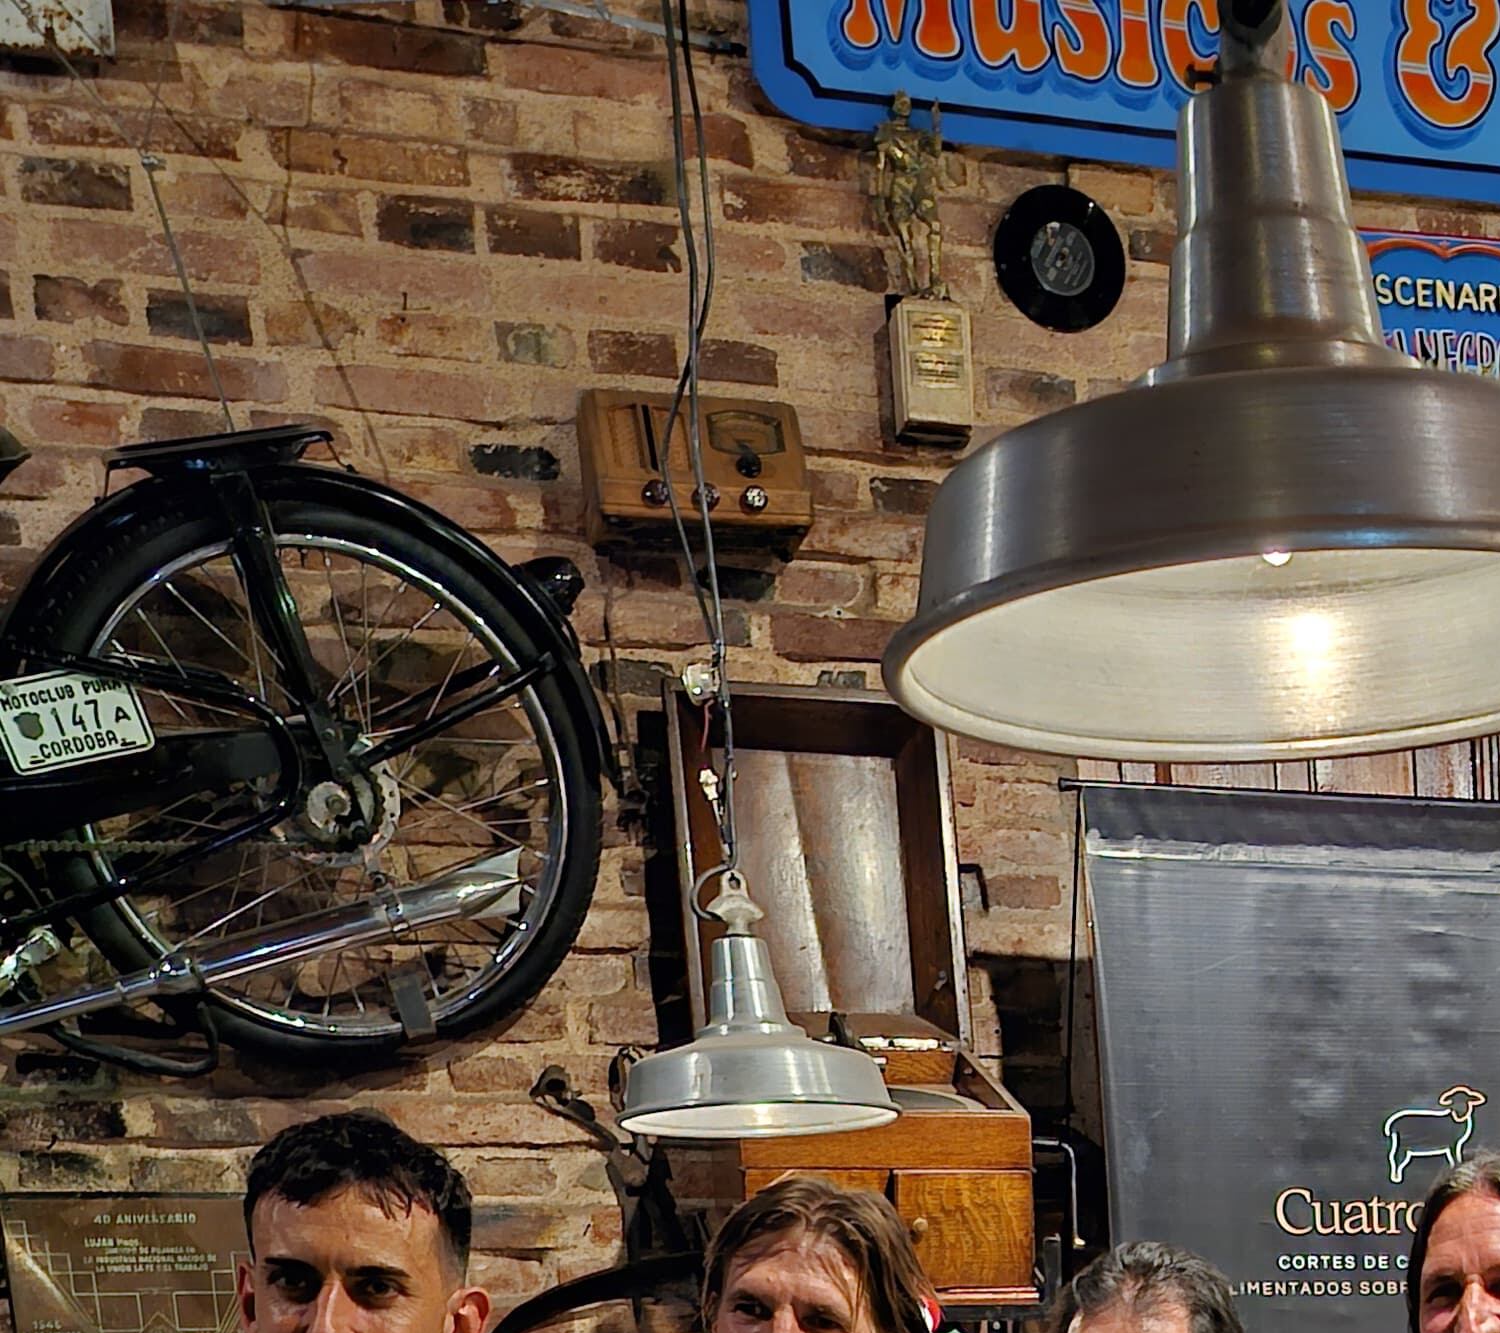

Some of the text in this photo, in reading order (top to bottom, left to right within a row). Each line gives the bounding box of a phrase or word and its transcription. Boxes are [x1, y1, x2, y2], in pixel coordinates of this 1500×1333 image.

[842, 0, 1360, 113] usics
[1, 684, 75, 712] MOTOCLUB
[51, 698, 132, 737] 147 A
[39, 729, 119, 759] CORDOBA
[1278, 1254, 1356, 1272] CORTES
[1363, 1256, 1390, 1271] DE
[1228, 1280, 1354, 1297] LIMENTADOS
